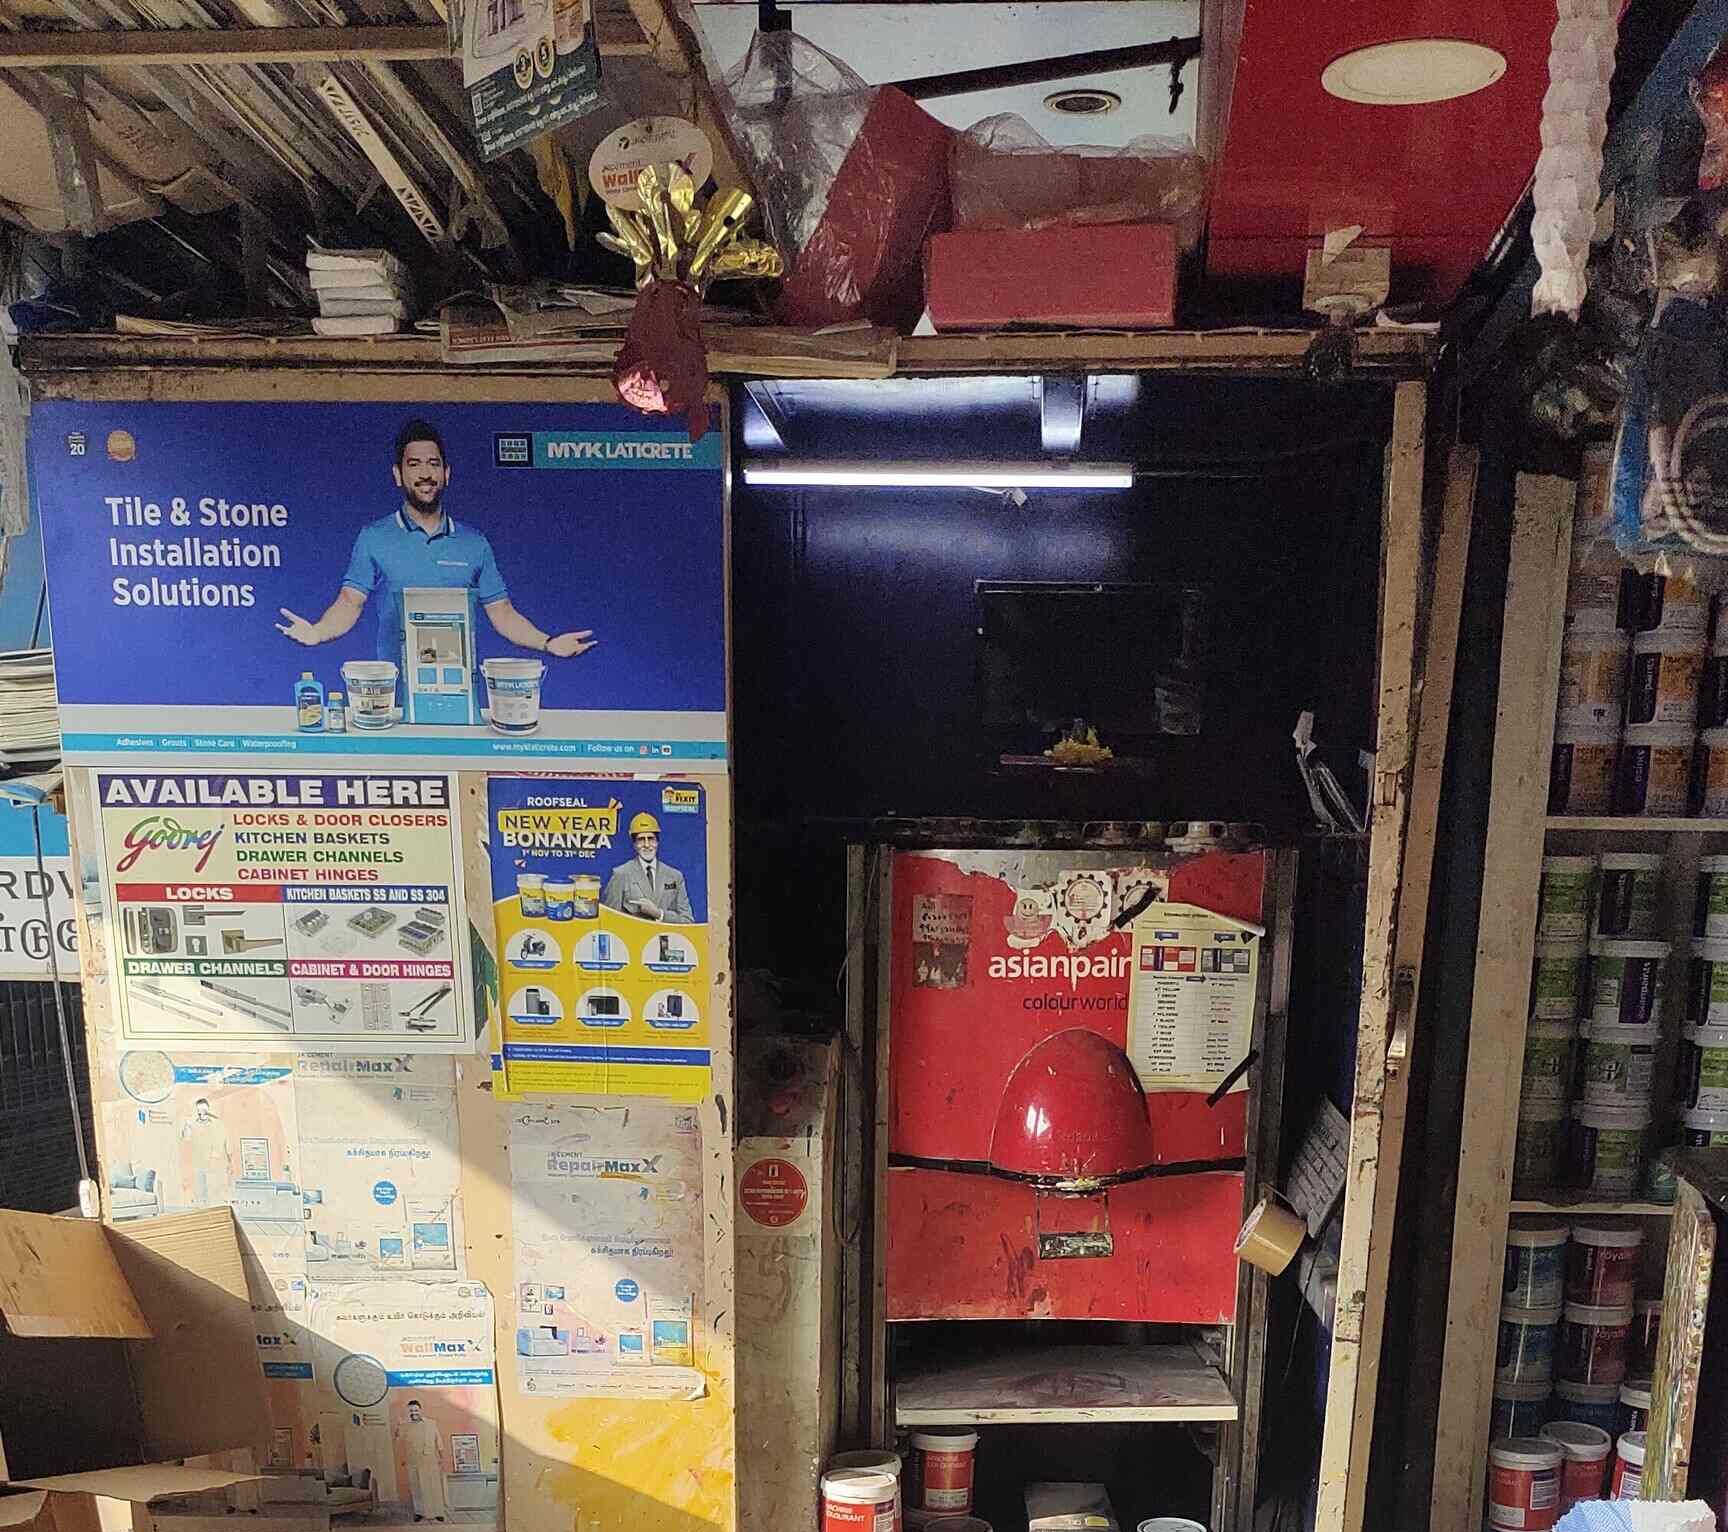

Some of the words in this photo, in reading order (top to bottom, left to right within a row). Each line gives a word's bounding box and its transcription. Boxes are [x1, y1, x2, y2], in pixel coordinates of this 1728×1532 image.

[602, 168, 641, 189] Wall
[70, 443, 85, 456] 20
[547, 442, 604, 458] MYK
[606, 442, 694, 460] LATICRETE
[105, 497, 161, 526] Tile
[169, 499, 191, 526] &
[199, 499, 288, 527] Stone
[110, 538, 281, 568] Installation
[112, 577, 255, 608] Solutions
[106, 779, 323, 805] AVAILABLE
[337, 780, 445, 805] HERE
[527, 797, 587, 807] ROOFSEAL
[233, 814, 289, 827] LOCKS
[297, 814, 307, 826] &
[314, 814, 362, 826] DOOR
[368, 814, 448, 827] CLOSERS
[506, 816, 550, 830] NEW
[559, 816, 610, 830] YEAR
[116, 815, 225, 873] Godrej
[235, 832, 309, 845] KITCHEN
[314, 832, 390, 845] BASKETS
[503, 832, 611, 849] BONANZA
[236, 850, 307, 863] DRAWER
[312, 850, 403, 863] CHANNELS
[238, 868, 309, 881] CABINET
[315, 868, 378, 881] HINGES
[167, 886, 233, 900] LOCKS
[287, 888, 327, 901] KITCHEN
[329, 888, 370, 901] BASKETS
[372, 889, 385, 901] SS
[387, 889, 407, 901] AND
[410, 889, 423, 901] SS
[426, 888, 446, 901] 304
[128, 962, 195, 975] DRAWER
[200, 961, 285, 975] CHANNELS
[292, 963, 346, 977] CABINET
[349, 964, 358, 977] &
[361, 963, 400, 977] DOOR
[403, 963, 452, 977] HINGES
[1023, 994, 1128, 1010] colourworld
